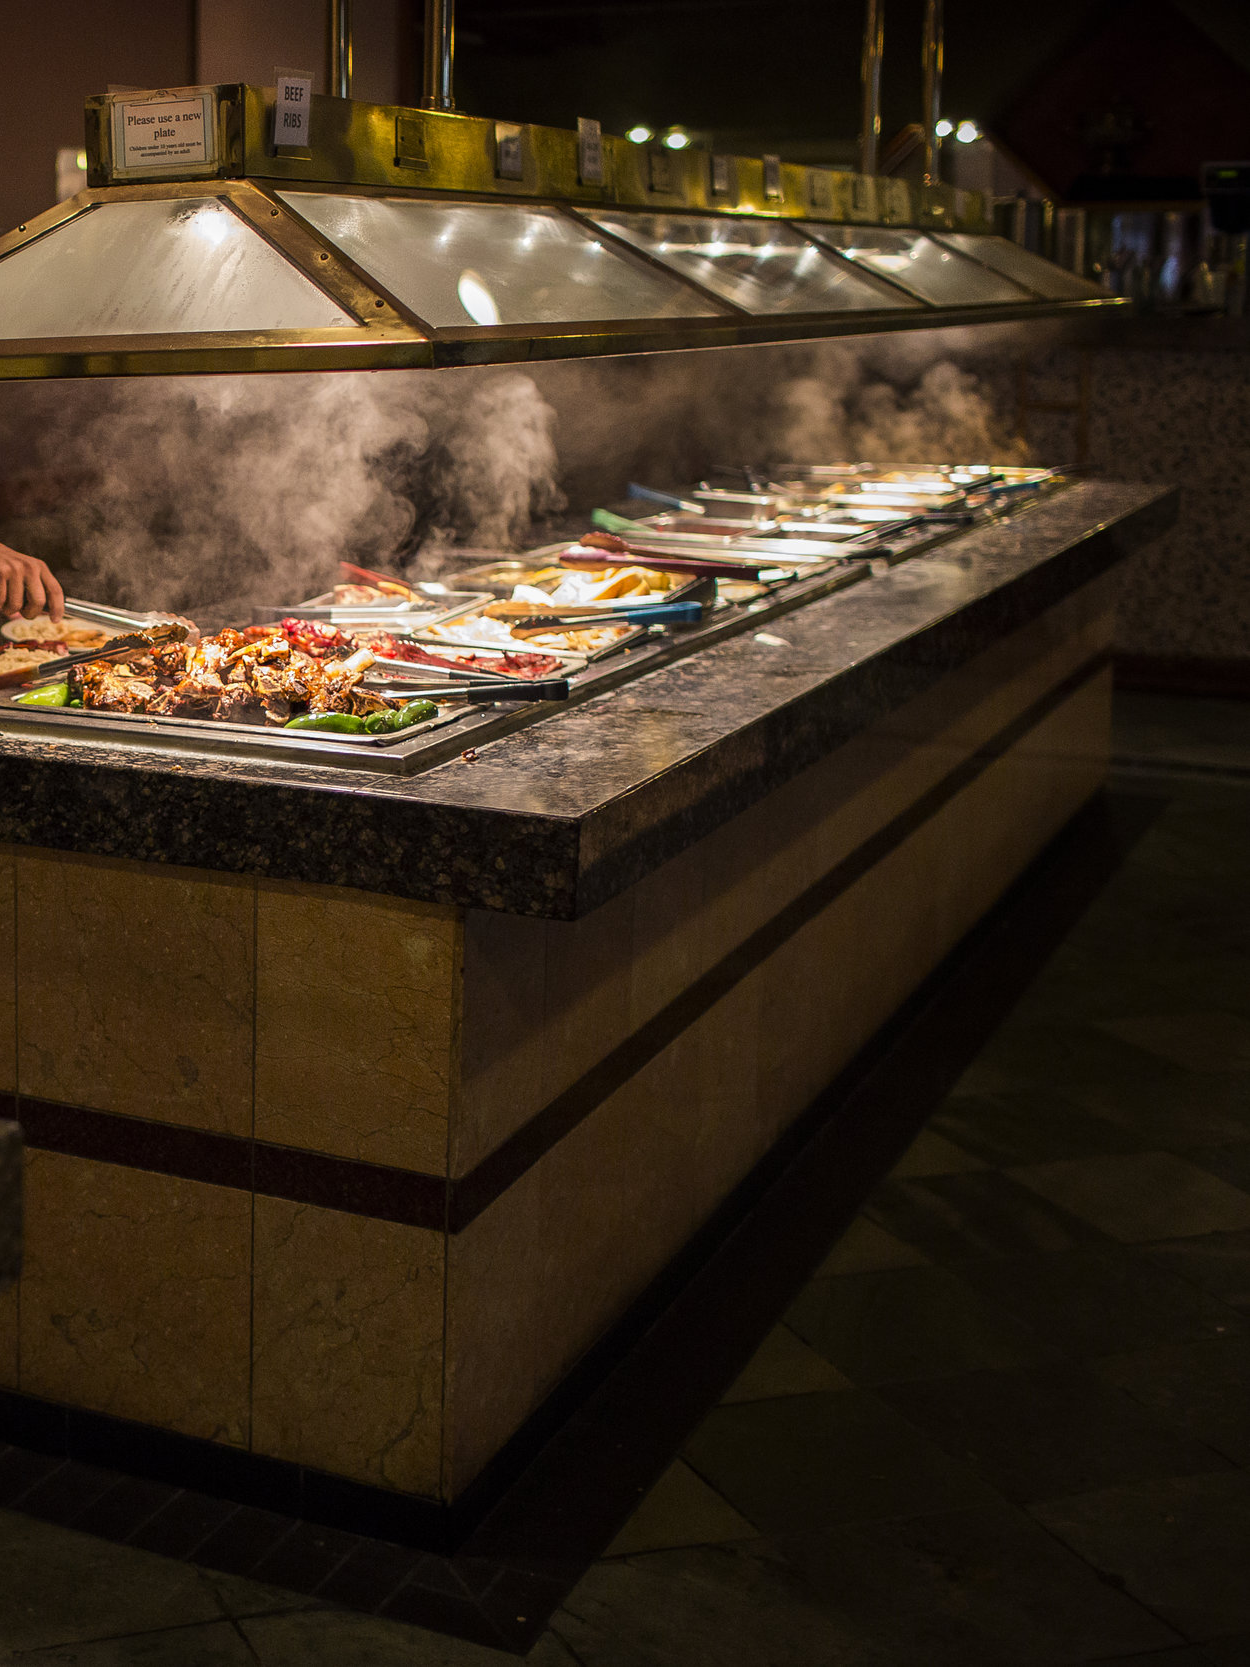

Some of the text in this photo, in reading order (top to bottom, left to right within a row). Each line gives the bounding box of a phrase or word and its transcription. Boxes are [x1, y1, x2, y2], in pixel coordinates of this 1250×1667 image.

[284, 85, 304, 102] BEEF
[128, 112, 202, 126] Please use a new
[283, 112, 302, 128] RIBS
[154, 127, 176, 140] plate
